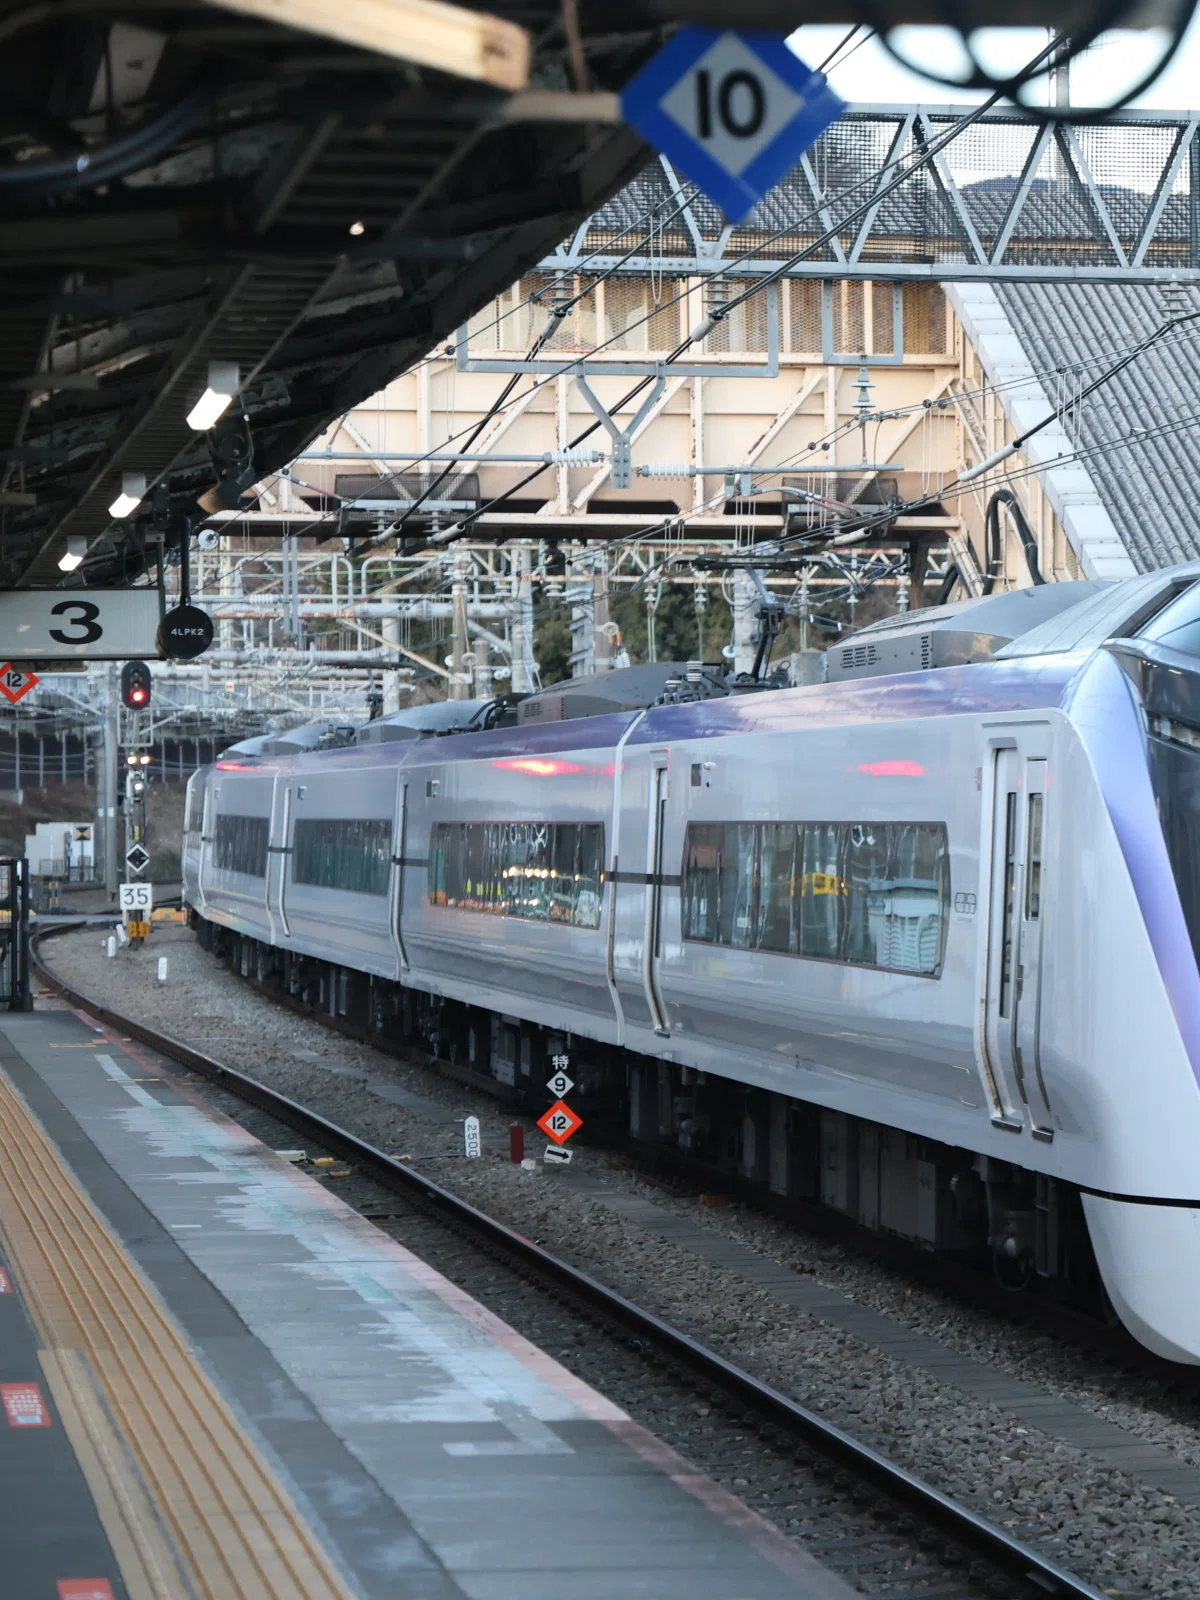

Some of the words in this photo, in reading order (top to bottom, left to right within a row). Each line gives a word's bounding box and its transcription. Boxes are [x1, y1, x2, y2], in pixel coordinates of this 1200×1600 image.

[697, 69, 766, 139] 10
[49, 601, 103, 645] 3
[171, 628, 204, 636] 4LPK2
[7, 673, 22, 688] 12
[123, 888, 148, 905] 35
[552, 1055, 569, 1070] 特
[555, 1078, 566, 1092] 9
[552, 1116, 566, 1130] 12
[467, 1124, 478, 1158] 2500
